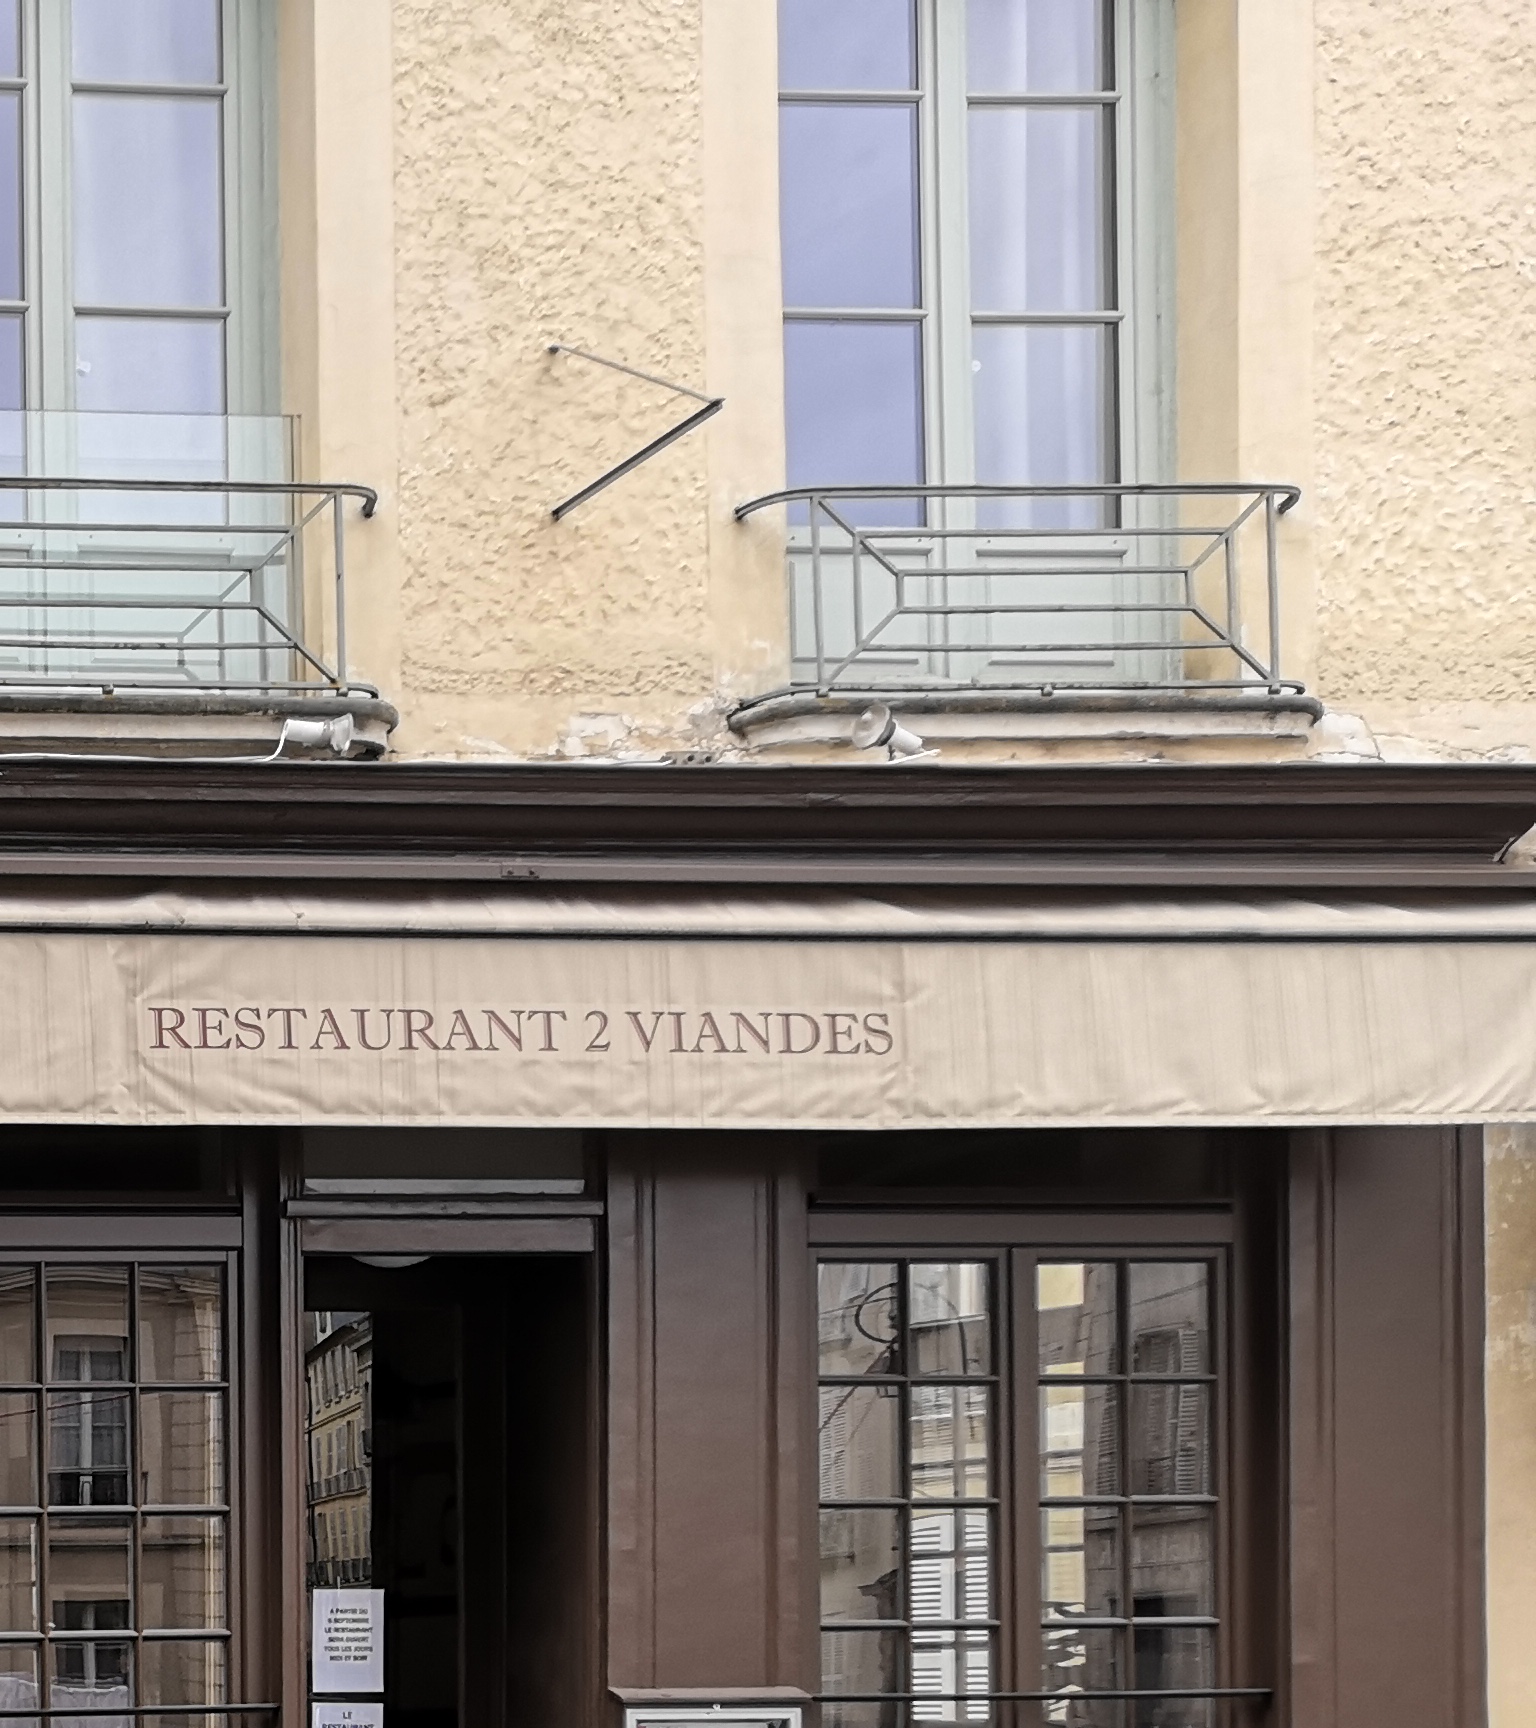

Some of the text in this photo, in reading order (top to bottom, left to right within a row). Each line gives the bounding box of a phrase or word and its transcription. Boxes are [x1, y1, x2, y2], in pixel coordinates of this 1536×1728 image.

[148, 1005, 895, 1057] RESTAURANT 2 VIANDES
[342, 1711, 352, 1719] LE
